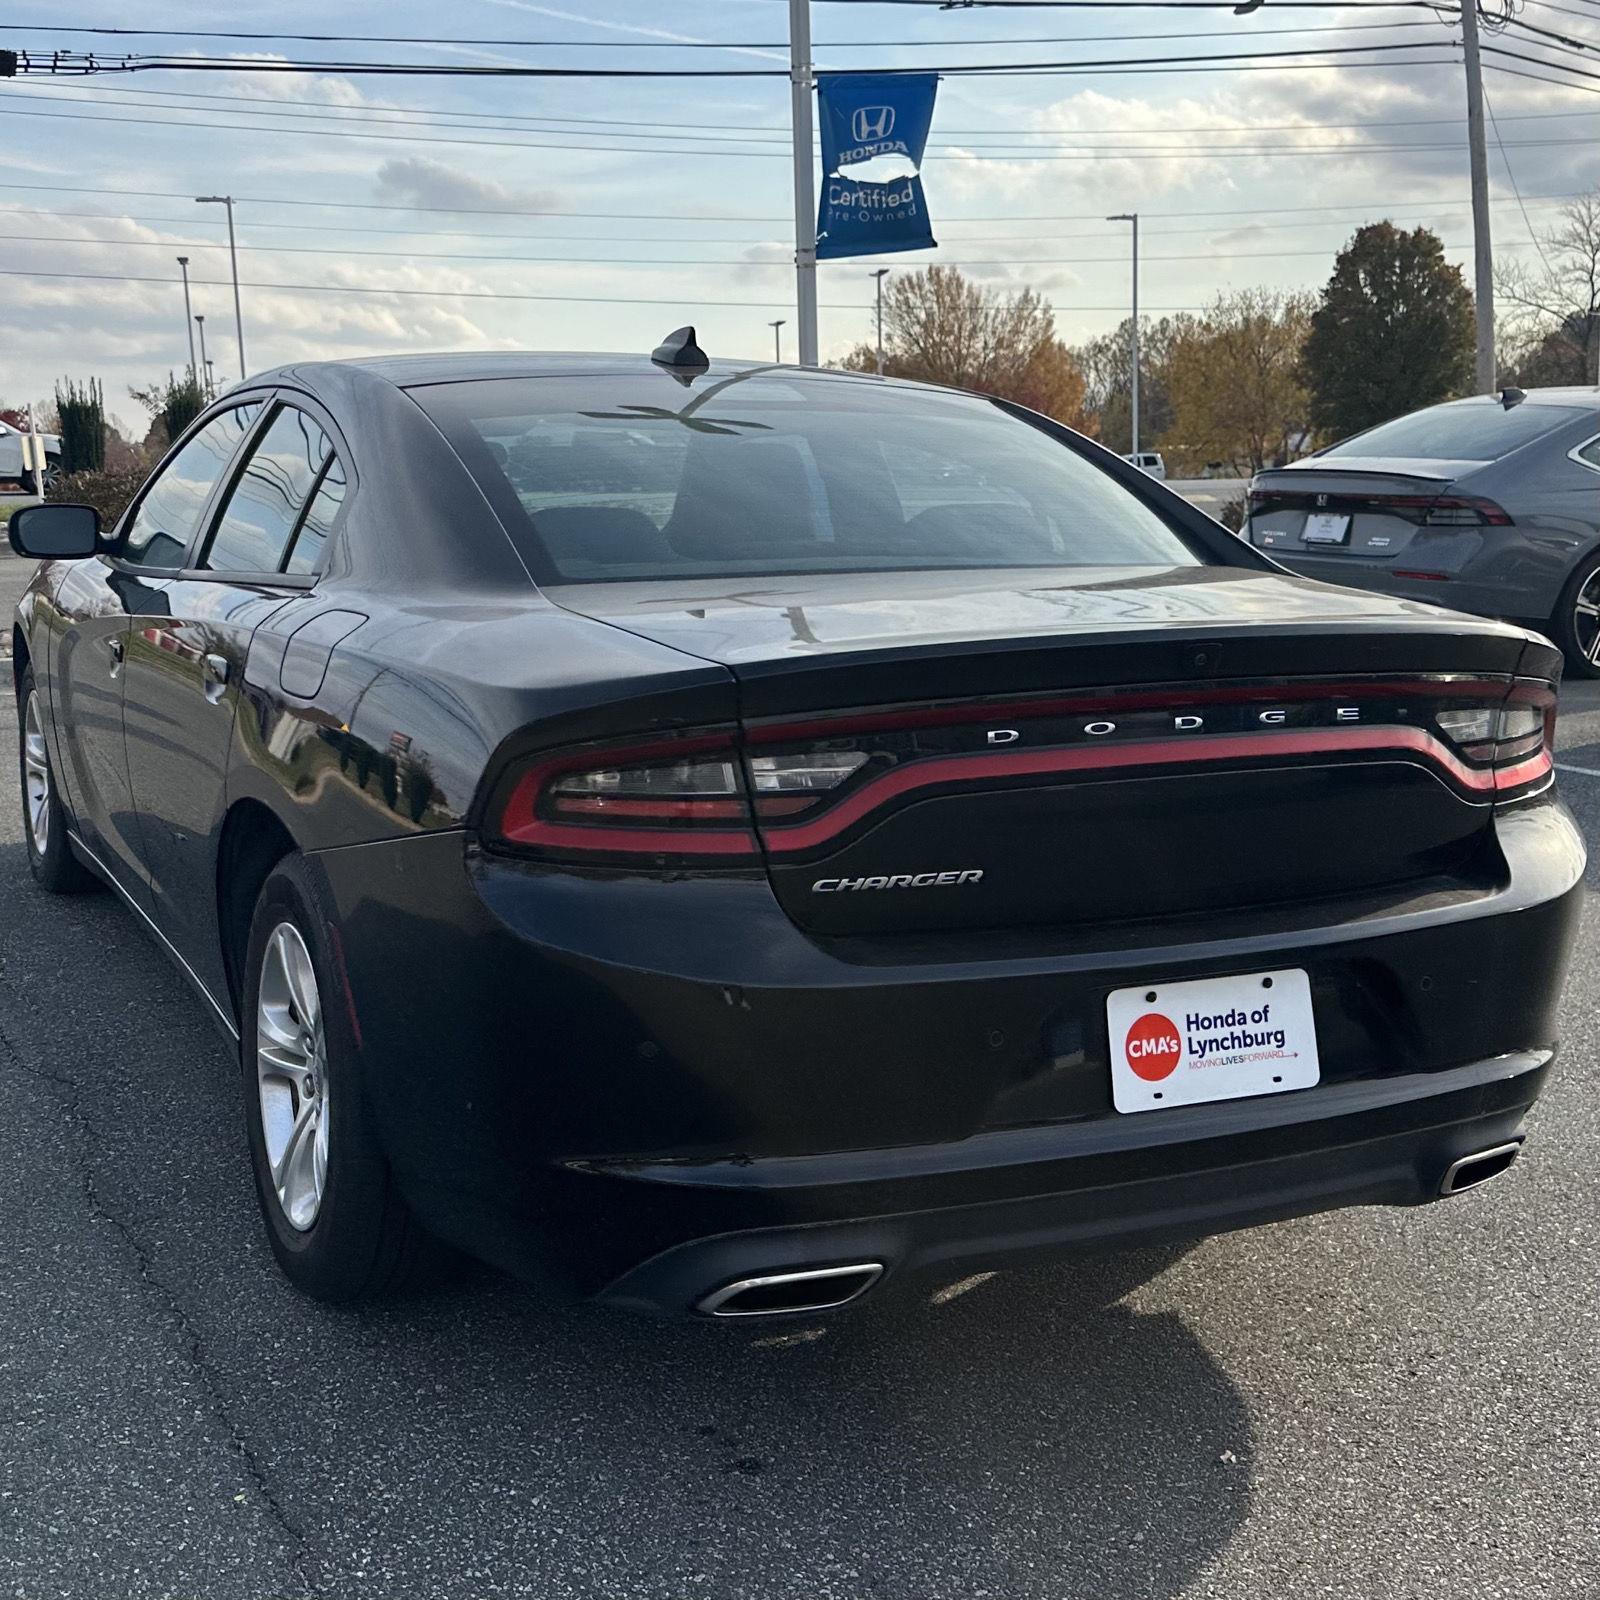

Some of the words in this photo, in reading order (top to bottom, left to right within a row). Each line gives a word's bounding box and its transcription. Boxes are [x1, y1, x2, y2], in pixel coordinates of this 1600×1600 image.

[839, 141, 909, 162] HONDA
[829, 180, 913, 208] Certified
[987, 707, 1359, 744] DODGE
[812, 870, 983, 892] CHARGER
[1186, 1008, 1247, 1032] Honda
[1250, 1004, 1270, 1024] of
[1128, 1035, 1179, 1058] CMA's
[1187, 1029, 1285, 1058] Lynchburg
